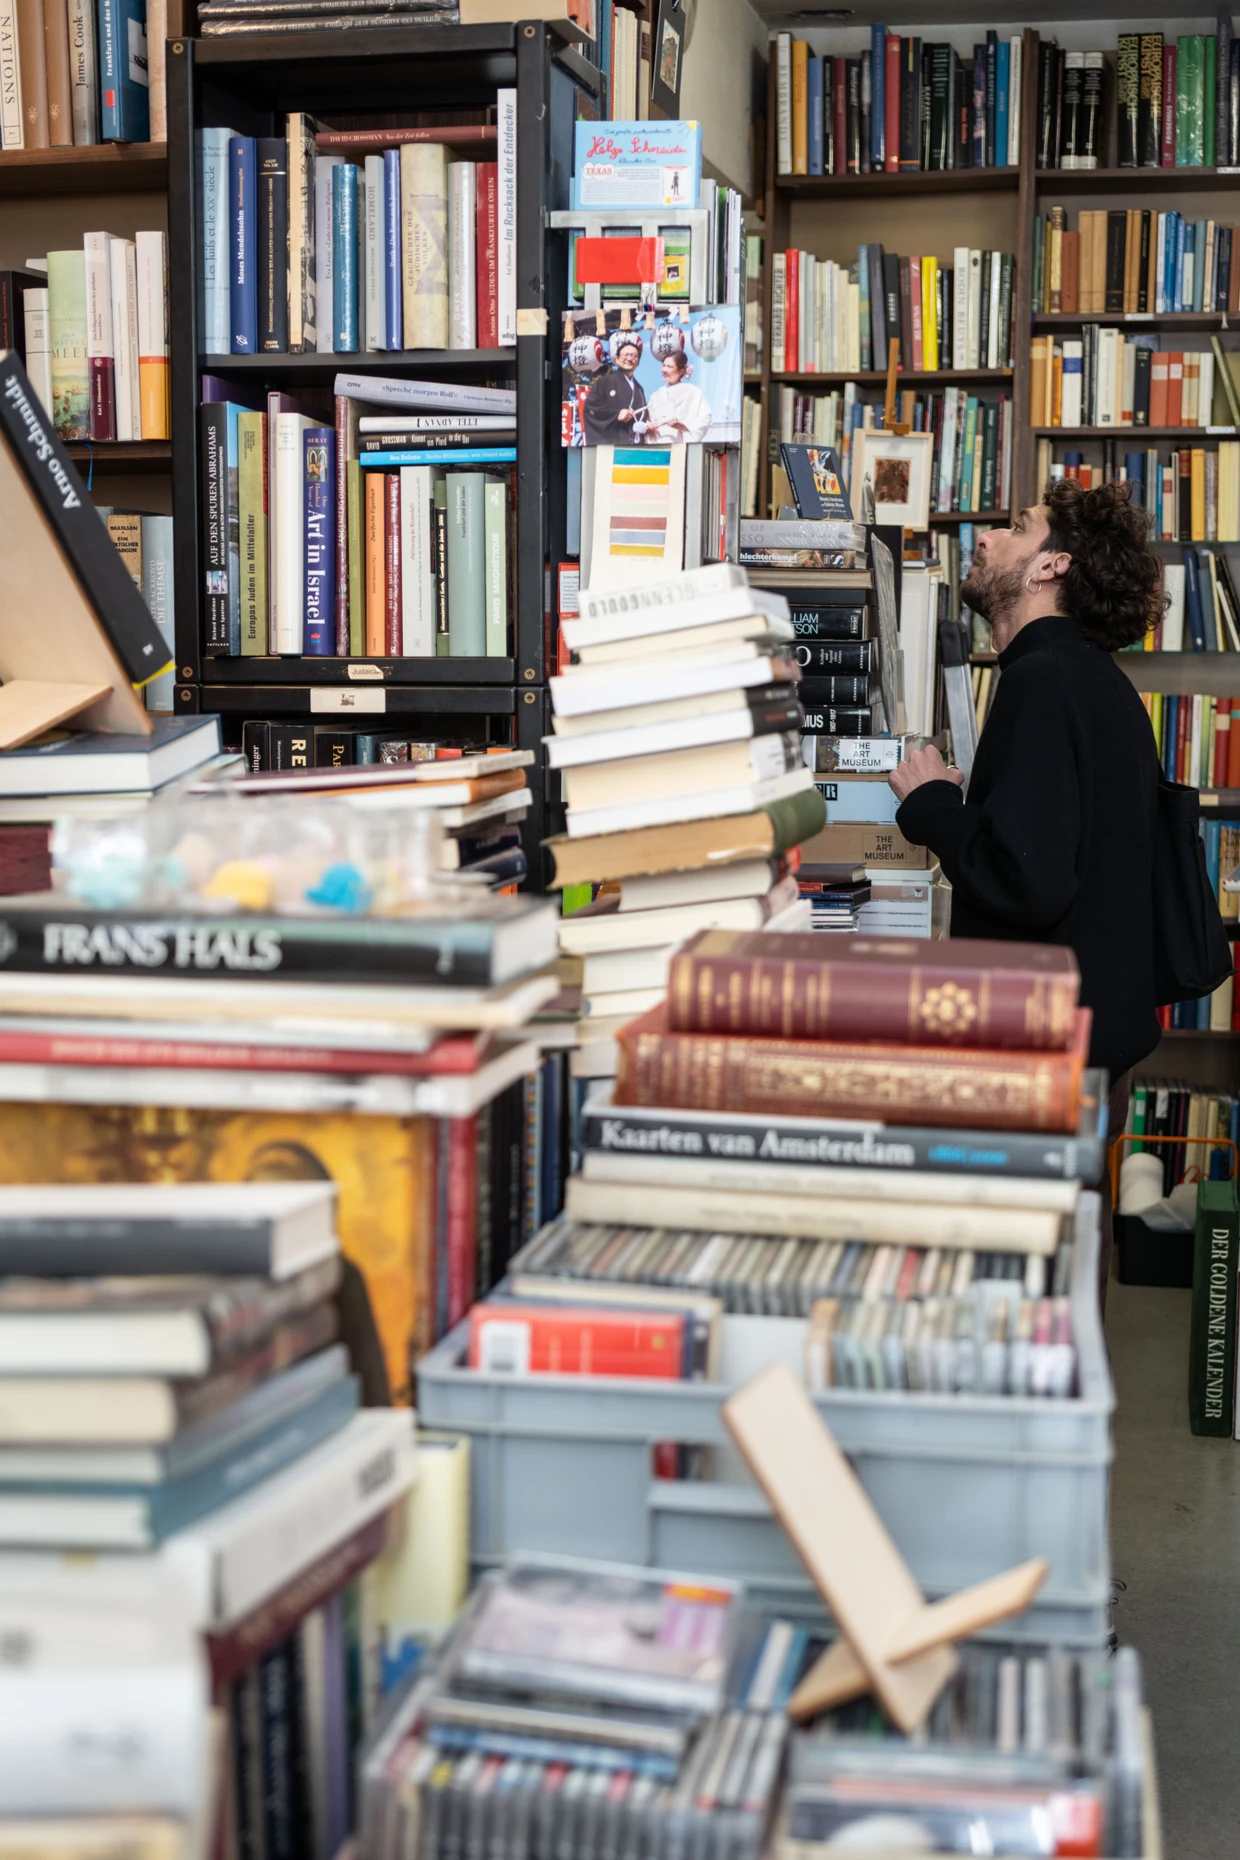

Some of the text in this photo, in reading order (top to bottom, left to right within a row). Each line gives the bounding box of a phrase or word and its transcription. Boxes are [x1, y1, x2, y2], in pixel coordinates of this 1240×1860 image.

[370, 18, 399, 26] SAMMLUNG
[0, 15, 15, 104] NATIONS
[73, 16, 88, 87] James Cook
[1117, 37, 1127, 76] KUNST
[1141, 35, 1151, 74] KUNST
[850, 66, 858, 106] Rembrandt?
[1126, 36, 1139, 120] EUROPÄISCHE
[1150, 34, 1162, 118] EUROPÄISCHE
[778, 64, 787, 142] REMBRANDT
[415, 132, 430, 140] fallen
[503, 103, 514, 155] Entdecker
[587, 136, 688, 159] Helge Schneider
[503, 157, 514, 174] der
[204, 165, 216, 281] Les Juifs et le siècle
[503, 177, 514, 227] Rucksack
[237, 210, 245, 260] Mendelssohn
[504, 230, 514, 241] Im
[489, 260, 495, 269] IM
[506, 268, 512, 276] Ed
[957, 267, 966, 304] RODIN
[773, 268, 783, 348] GERHARD RICHTER
[4, 374, 82, 510] Arno Schmidt
[366, 442, 380, 450] DAVID
[382, 435, 407, 444] GROSSMAN
[411, 435, 426, 443] Kommt
[435, 437, 447, 446] Pferd
[458, 418, 478, 426] ETEL
[208, 426, 218, 565] AUF DEN SPUREN ABRAHAMS
[246, 513, 257, 639] Europas Juden im Mittelalter
[307, 509, 326, 625] Art in Israel
[490, 532, 500, 594] MAGNÉTIQUE
[740, 552, 797, 561] hlechterkampf
[157, 560, 165, 602] THEMSE
[841, 759, 881, 767] MUSEUM
[864, 852, 904, 860] MUSEUM
[876, 835, 893, 843] THE
[42, 922, 283, 972] FRANS HALS
[599, 1118, 915, 1167] Kaarten van Amsterdam
[1205, 1228, 1229, 1419] DER GOLDENE KALENDER
